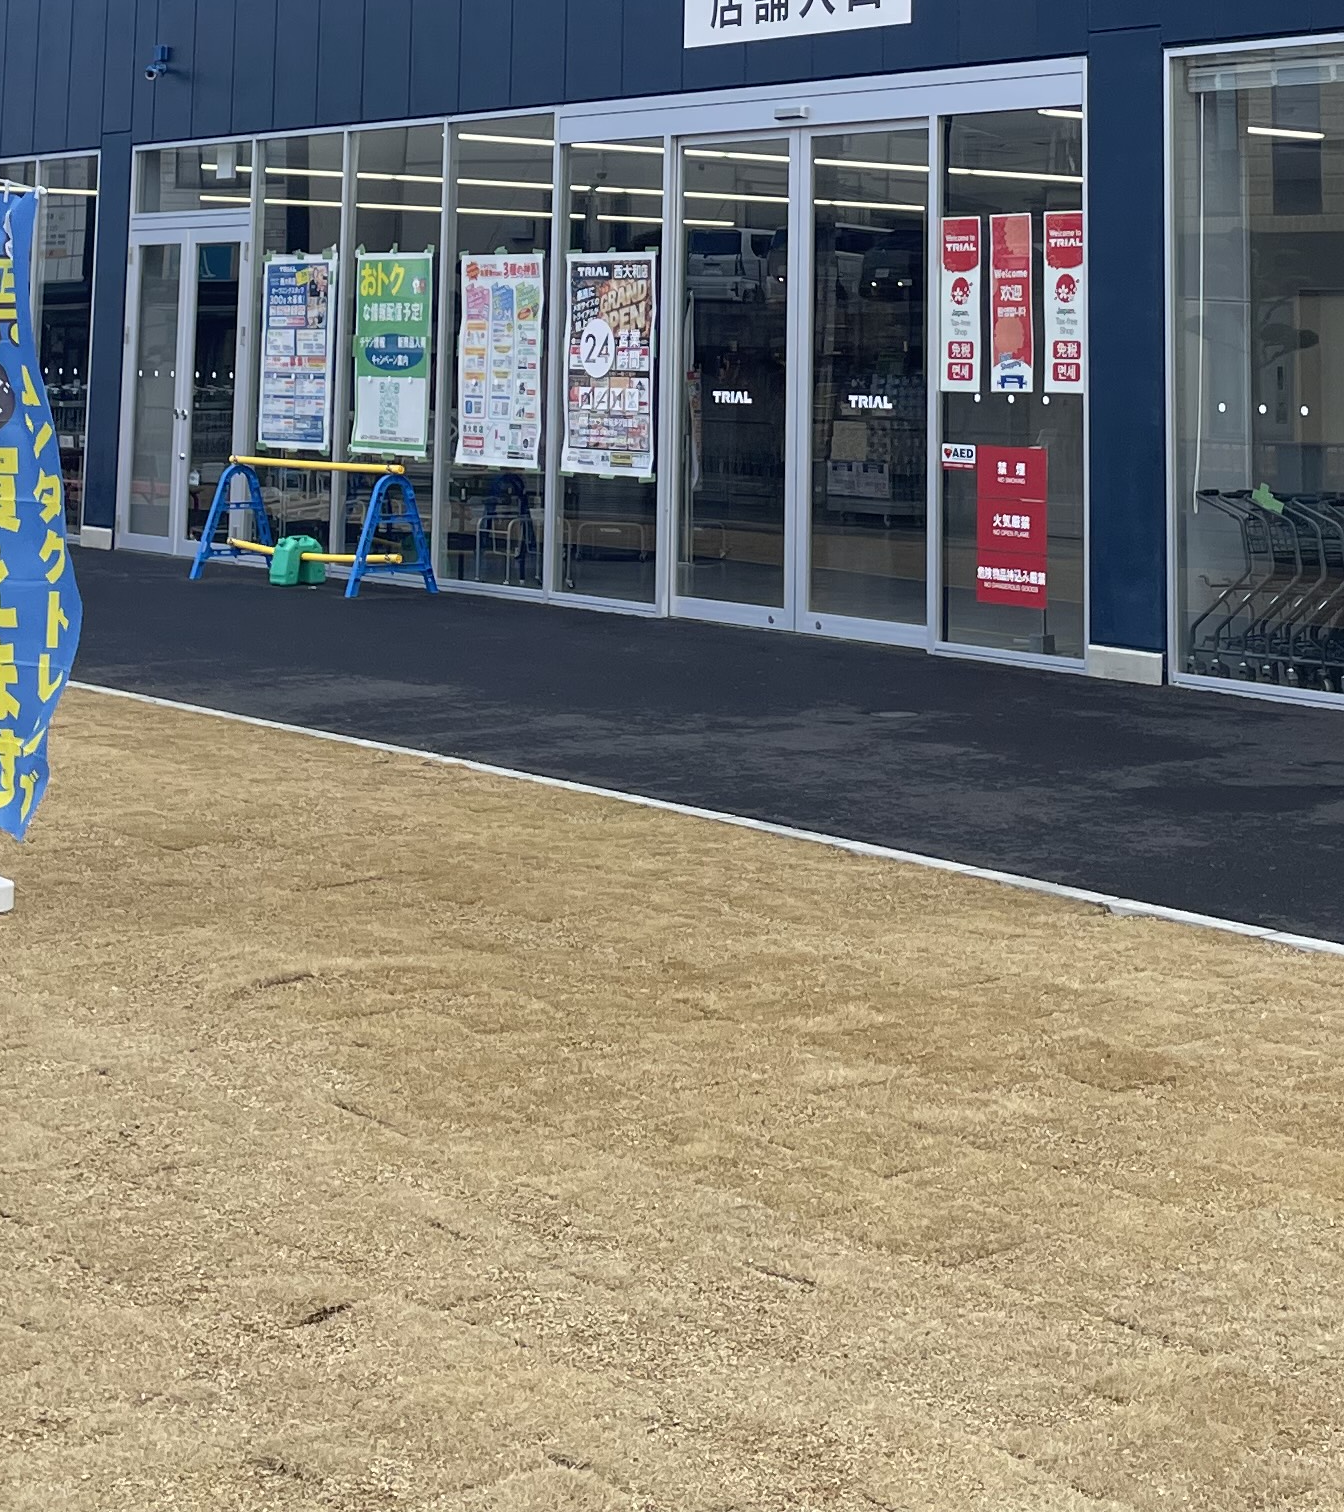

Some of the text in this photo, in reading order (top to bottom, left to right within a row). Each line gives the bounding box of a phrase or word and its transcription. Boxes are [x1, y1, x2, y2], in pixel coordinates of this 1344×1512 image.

[946, 243, 976, 251] TRIAL
[1049, 238, 1083, 247] TRIAL
[360, 262, 406, 297] おトク
[577, 267, 609, 277] TRIAL
[994, 269, 1028, 279] Welcome
[600, 279, 647, 313] GRAND
[1000, 284, 1023, 302] 欢迎
[618, 328, 641, 347] 営業
[584, 333, 610, 363] 24
[950, 343, 971, 358] 免税
[1056, 343, 1078, 358] 免税
[617, 349, 640, 369] 時間
[712, 390, 753, 404] TRIAL
[848, 394, 893, 409] TRIAL
[952, 448, 974, 459] AED
[992, 513, 1030, 530] 火気厳禁
